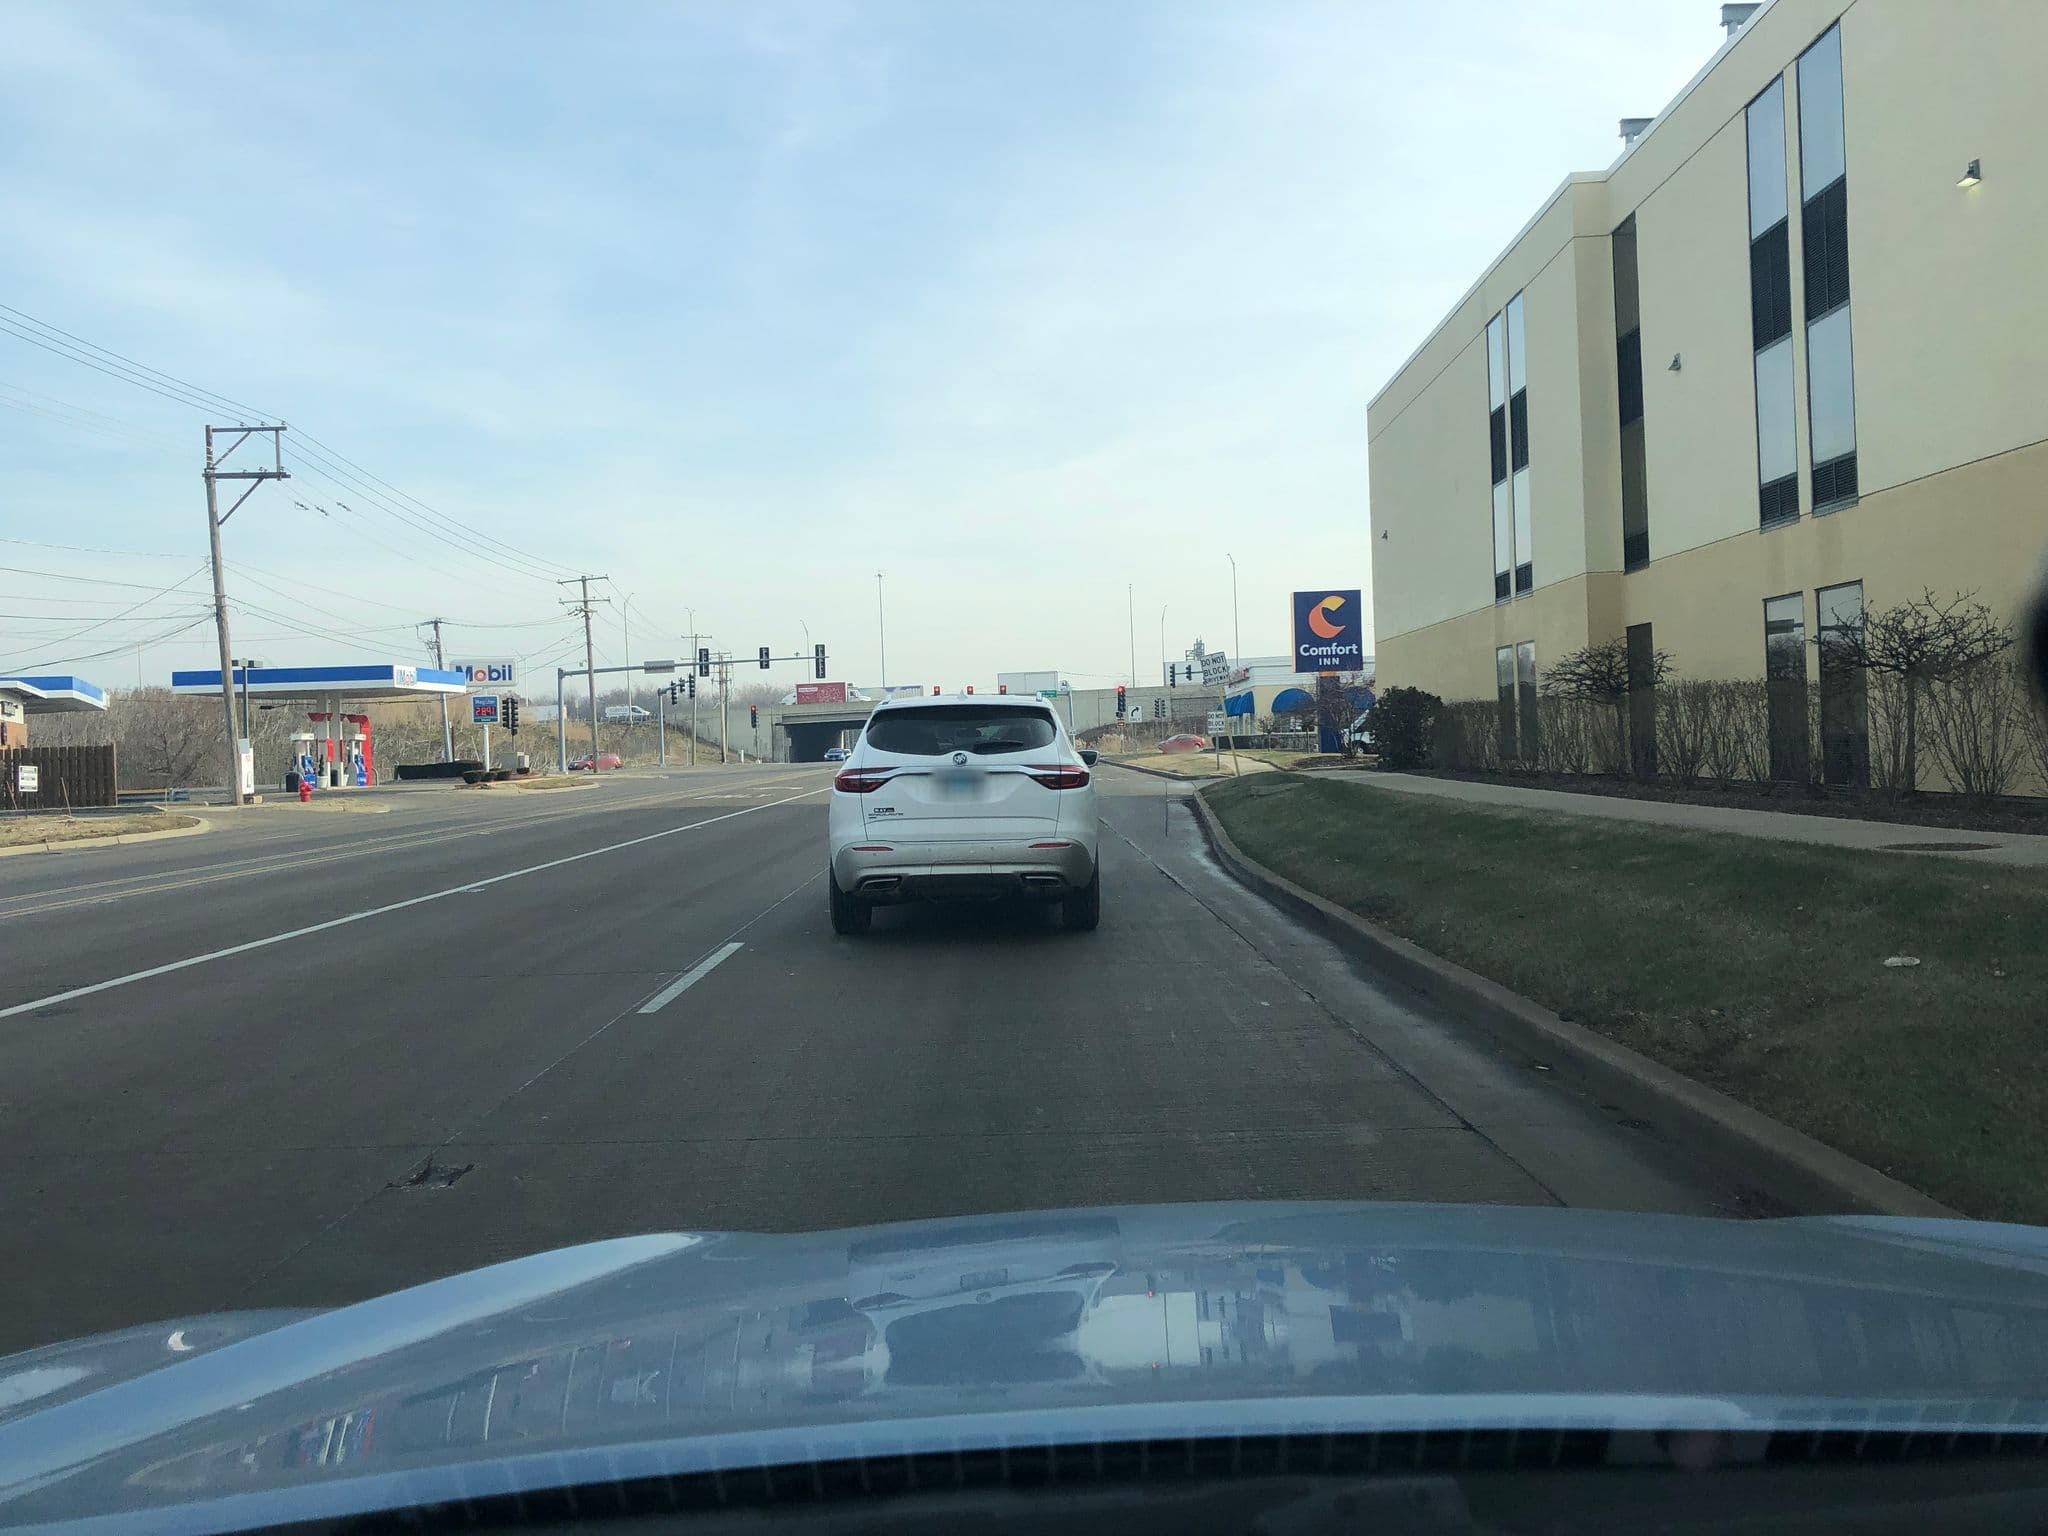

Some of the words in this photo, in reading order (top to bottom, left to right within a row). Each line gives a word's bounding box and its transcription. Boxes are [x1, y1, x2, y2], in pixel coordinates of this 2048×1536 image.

[1300, 642, 1358, 656] Comfort
[1201, 659, 1210, 667] DO
[1212, 656, 1225, 665] NOT
[1319, 657, 1340, 666] INN
[456, 664, 513, 682] Mobil
[1203, 666, 1227, 677] BLOCK
